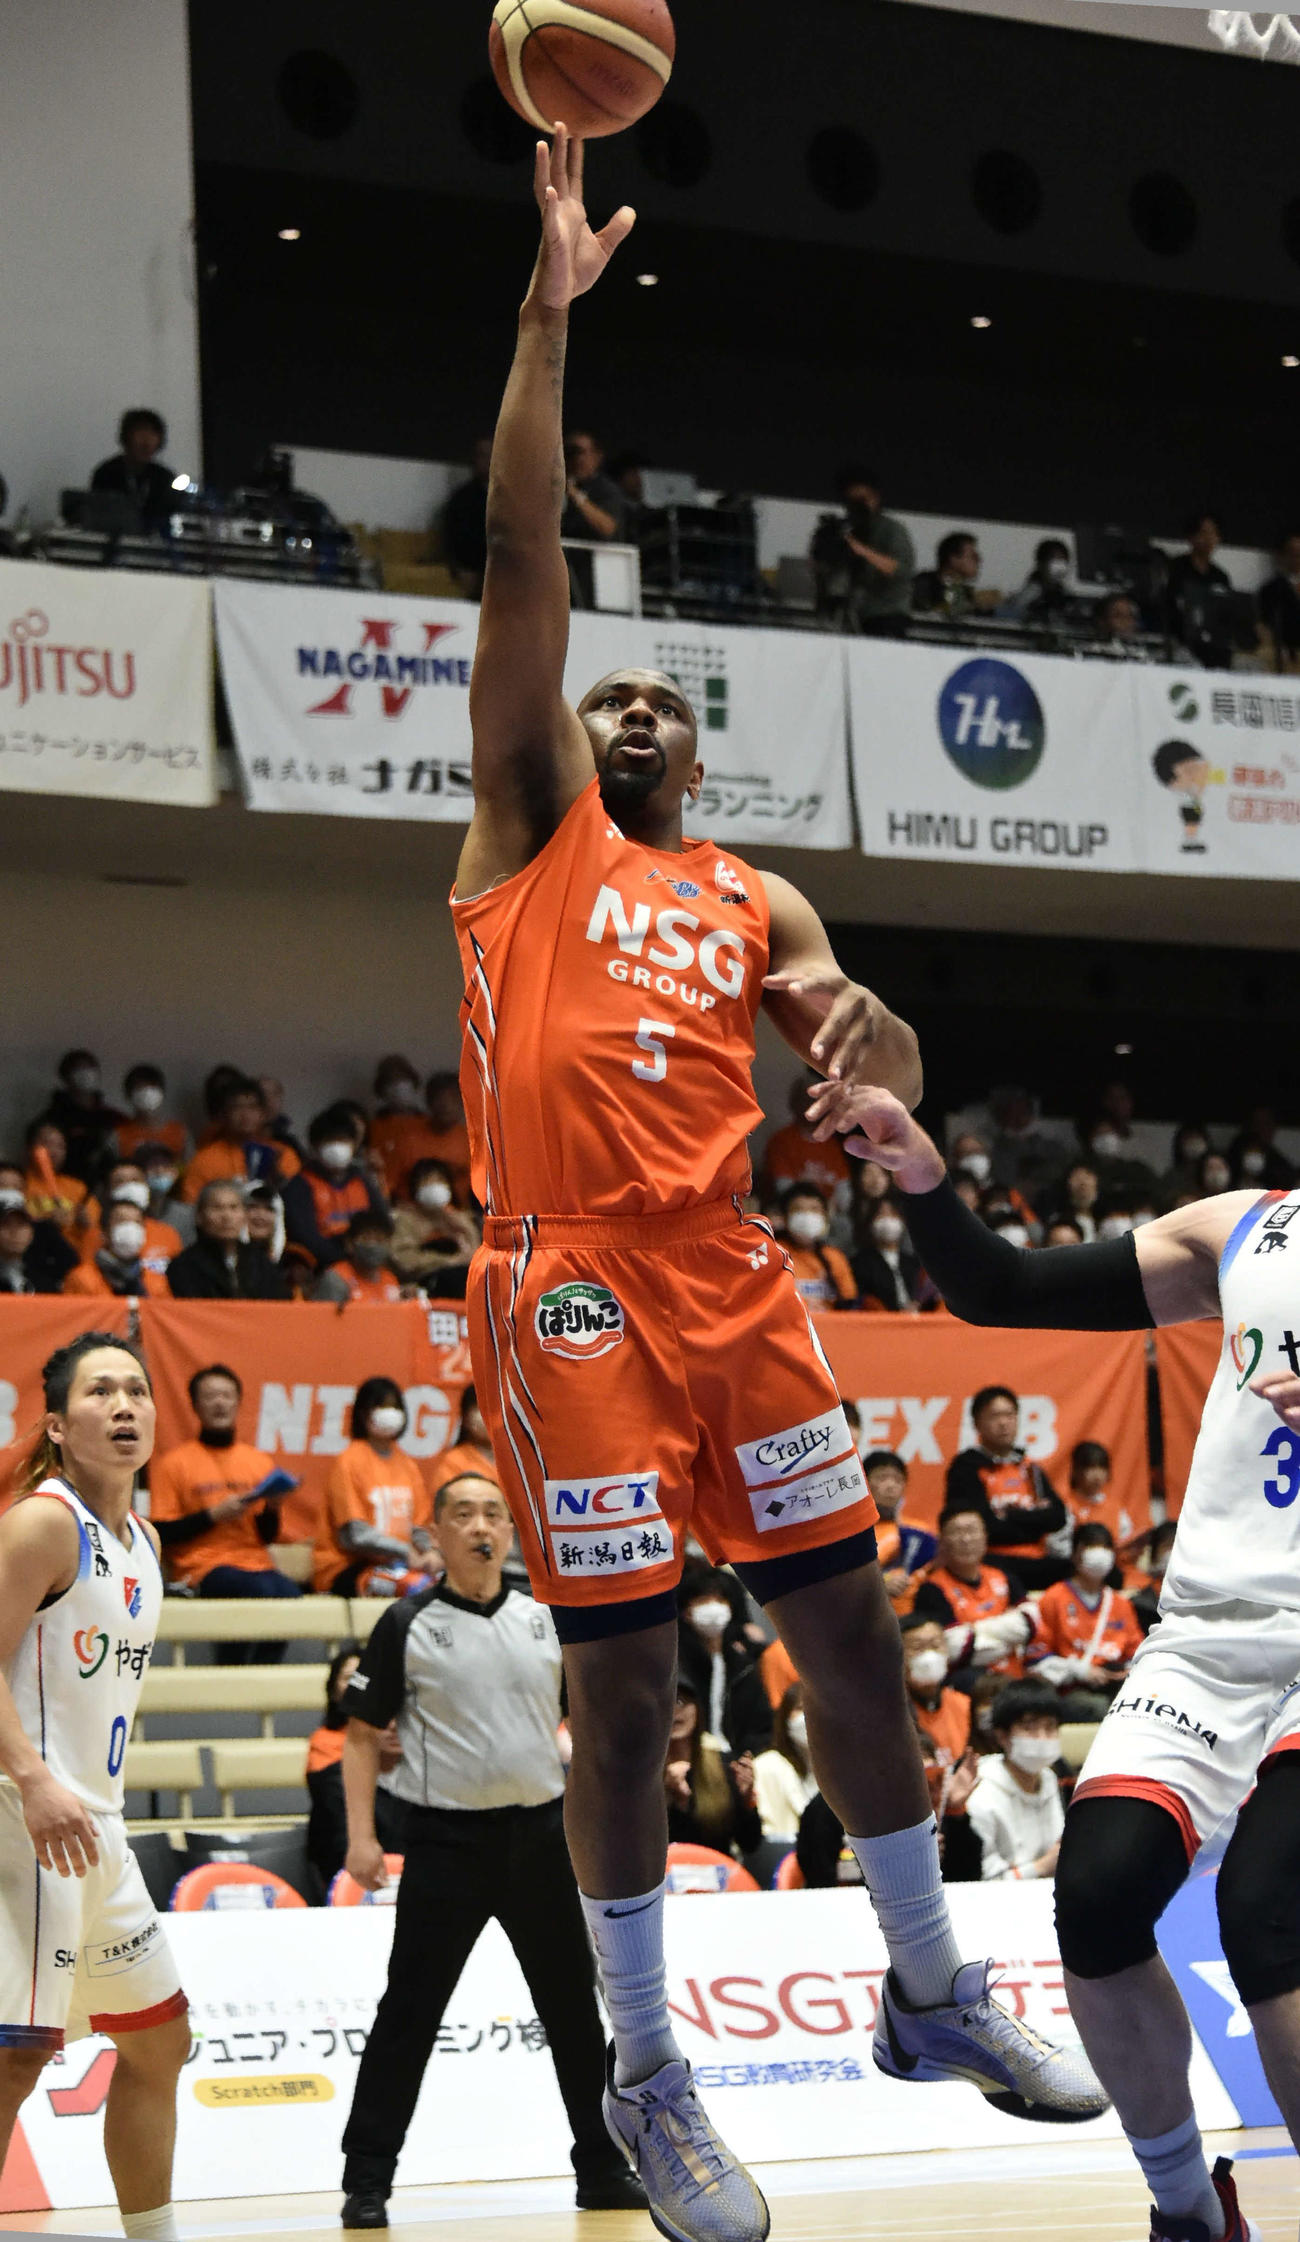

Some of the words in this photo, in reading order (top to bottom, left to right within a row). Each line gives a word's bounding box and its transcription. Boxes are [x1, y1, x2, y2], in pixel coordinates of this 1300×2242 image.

[297, 647, 471, 687] NAGAMINE
[0, 729, 202, 770] ニケーションサービス
[888, 811, 977, 850] HIMU
[991, 817, 1109, 858] GROUP
[586, 883, 745, 1000] NSG
[607, 959, 716, 1013] GROUP
[632, 1017, 675, 1083] 5
[538, 1299, 620, 1338] ぱりんこ
[755, 1425, 834, 1467] Crafty
[555, 1481, 650, 1516] NCT
[785, 1473, 861, 1509] アオーレ長岡
[560, 1531, 668, 1569] 新潟日報
[107, 1714, 127, 1778] 0
[211, 2080, 319, 2101] Scratch部門
